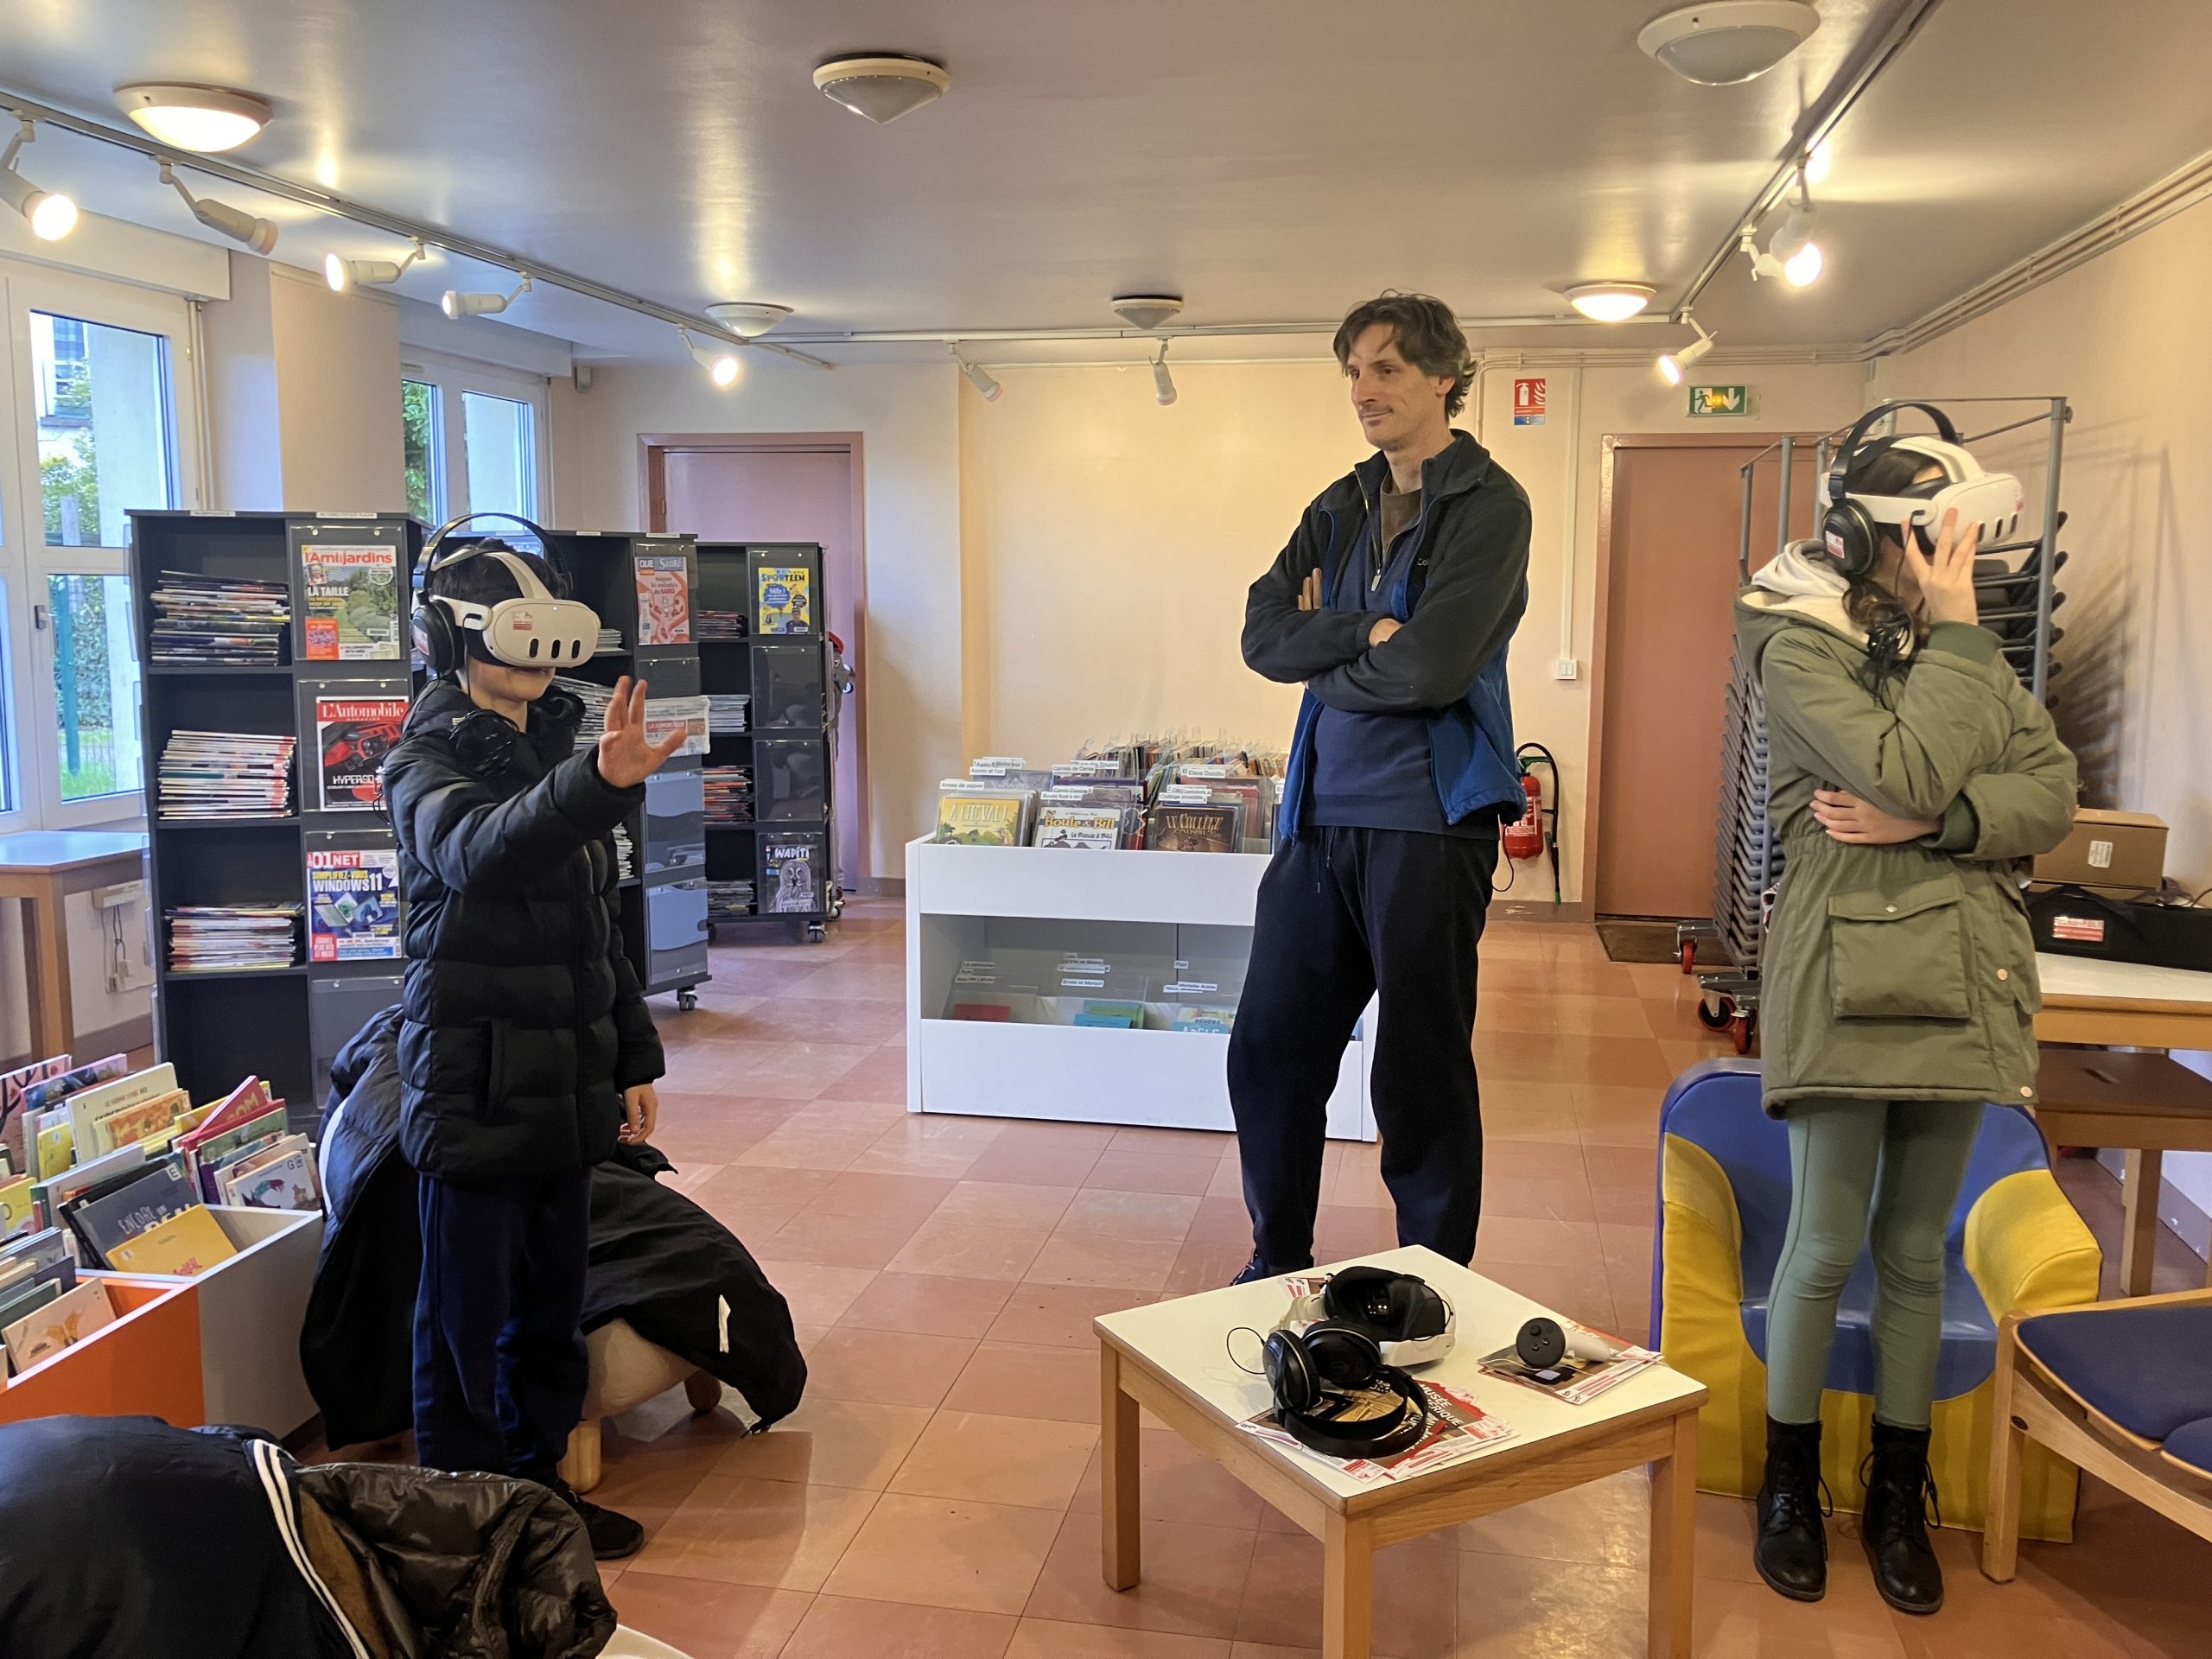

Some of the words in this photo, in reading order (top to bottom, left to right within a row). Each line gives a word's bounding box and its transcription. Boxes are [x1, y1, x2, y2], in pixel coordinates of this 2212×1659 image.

[342, 552, 392, 565] jardins
[659, 558, 683, 569] Santé
[308, 587, 319, 597] LA
[321, 587, 350, 597] TAILLE
[322, 702, 404, 719] L'Automobile
[333, 774, 375, 785] HYPERSO
[961, 804, 1001, 823] CHEVAL
[1044, 816, 1081, 828] Boule
[1093, 817, 1116, 829] Bill
[313, 879, 370, 892] WINDOWS
[369, 873, 383, 891] 11
